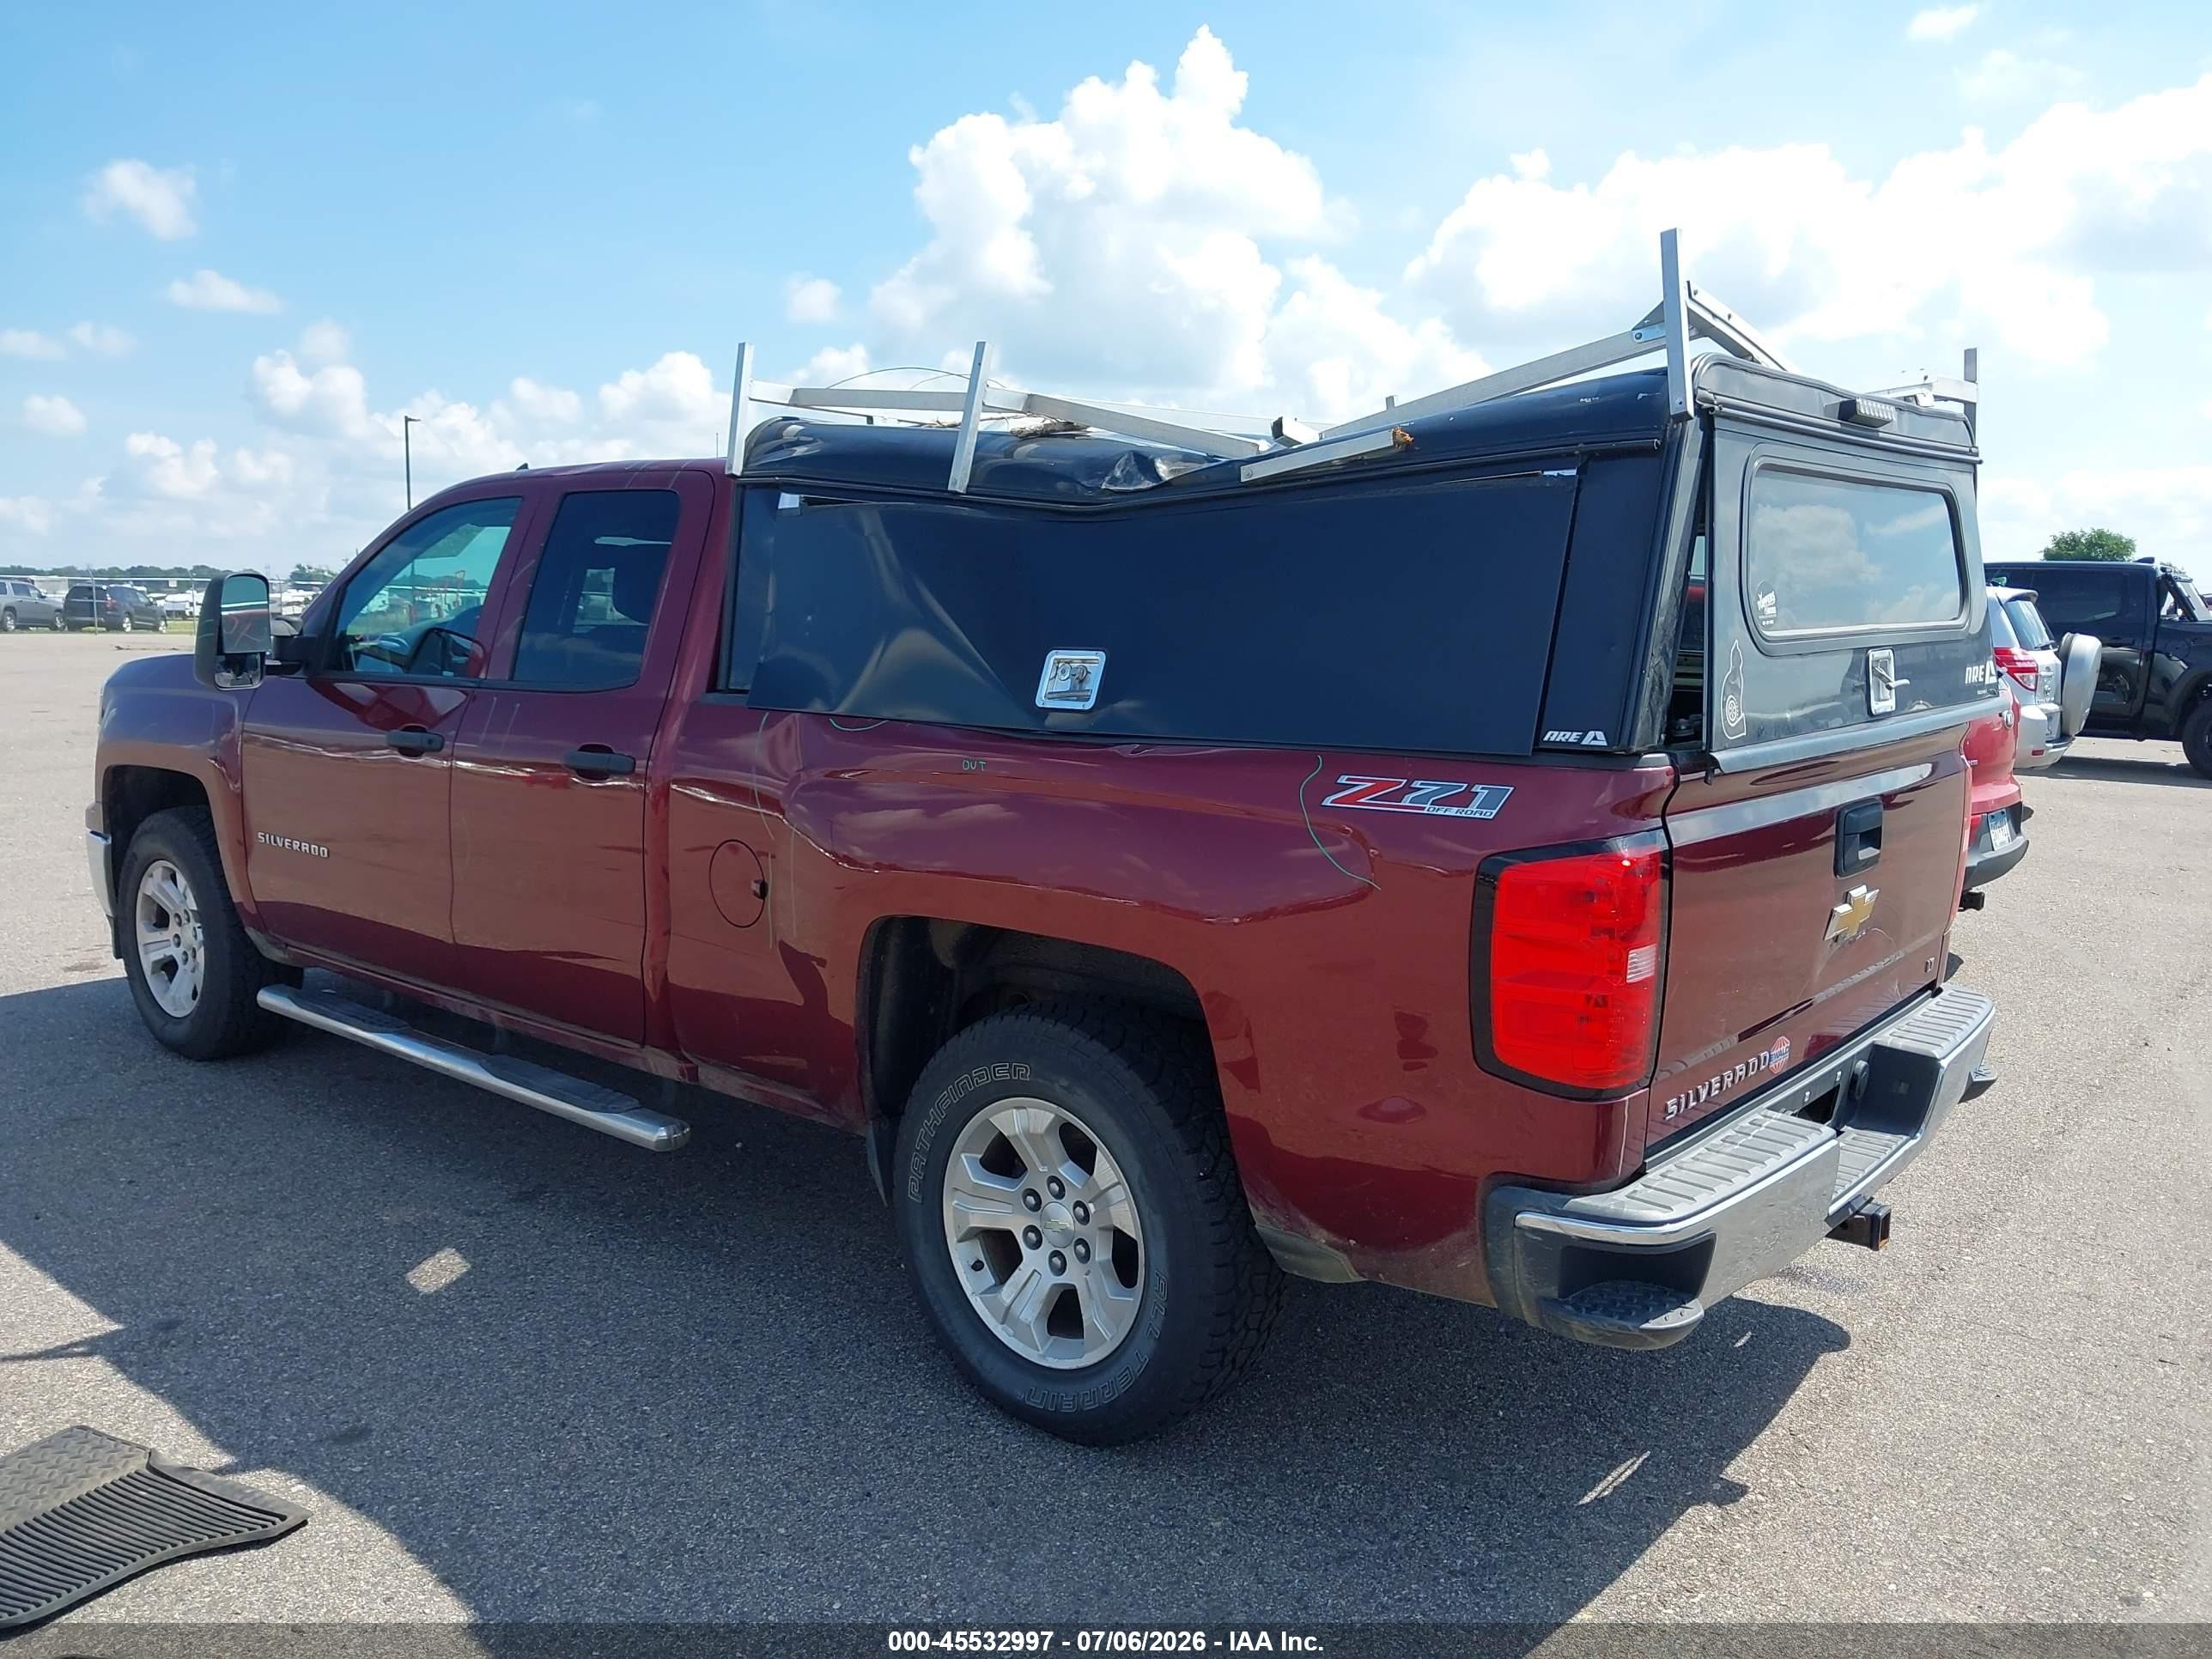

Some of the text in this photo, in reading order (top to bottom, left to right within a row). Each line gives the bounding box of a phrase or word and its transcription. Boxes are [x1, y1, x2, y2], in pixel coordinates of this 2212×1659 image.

[1543, 730, 1583, 743] ARE
[1321, 775, 1515, 811] Z71
[1426, 805, 1494, 818] OFF ROAD
[257, 831, 329, 858] SILVERADO
[1664, 1050, 1770, 1121] SILVERADO
[908, 1062, 1031, 1203] PATHFINDER
[1024, 1270, 1169, 1413] ALL TERRAIN
